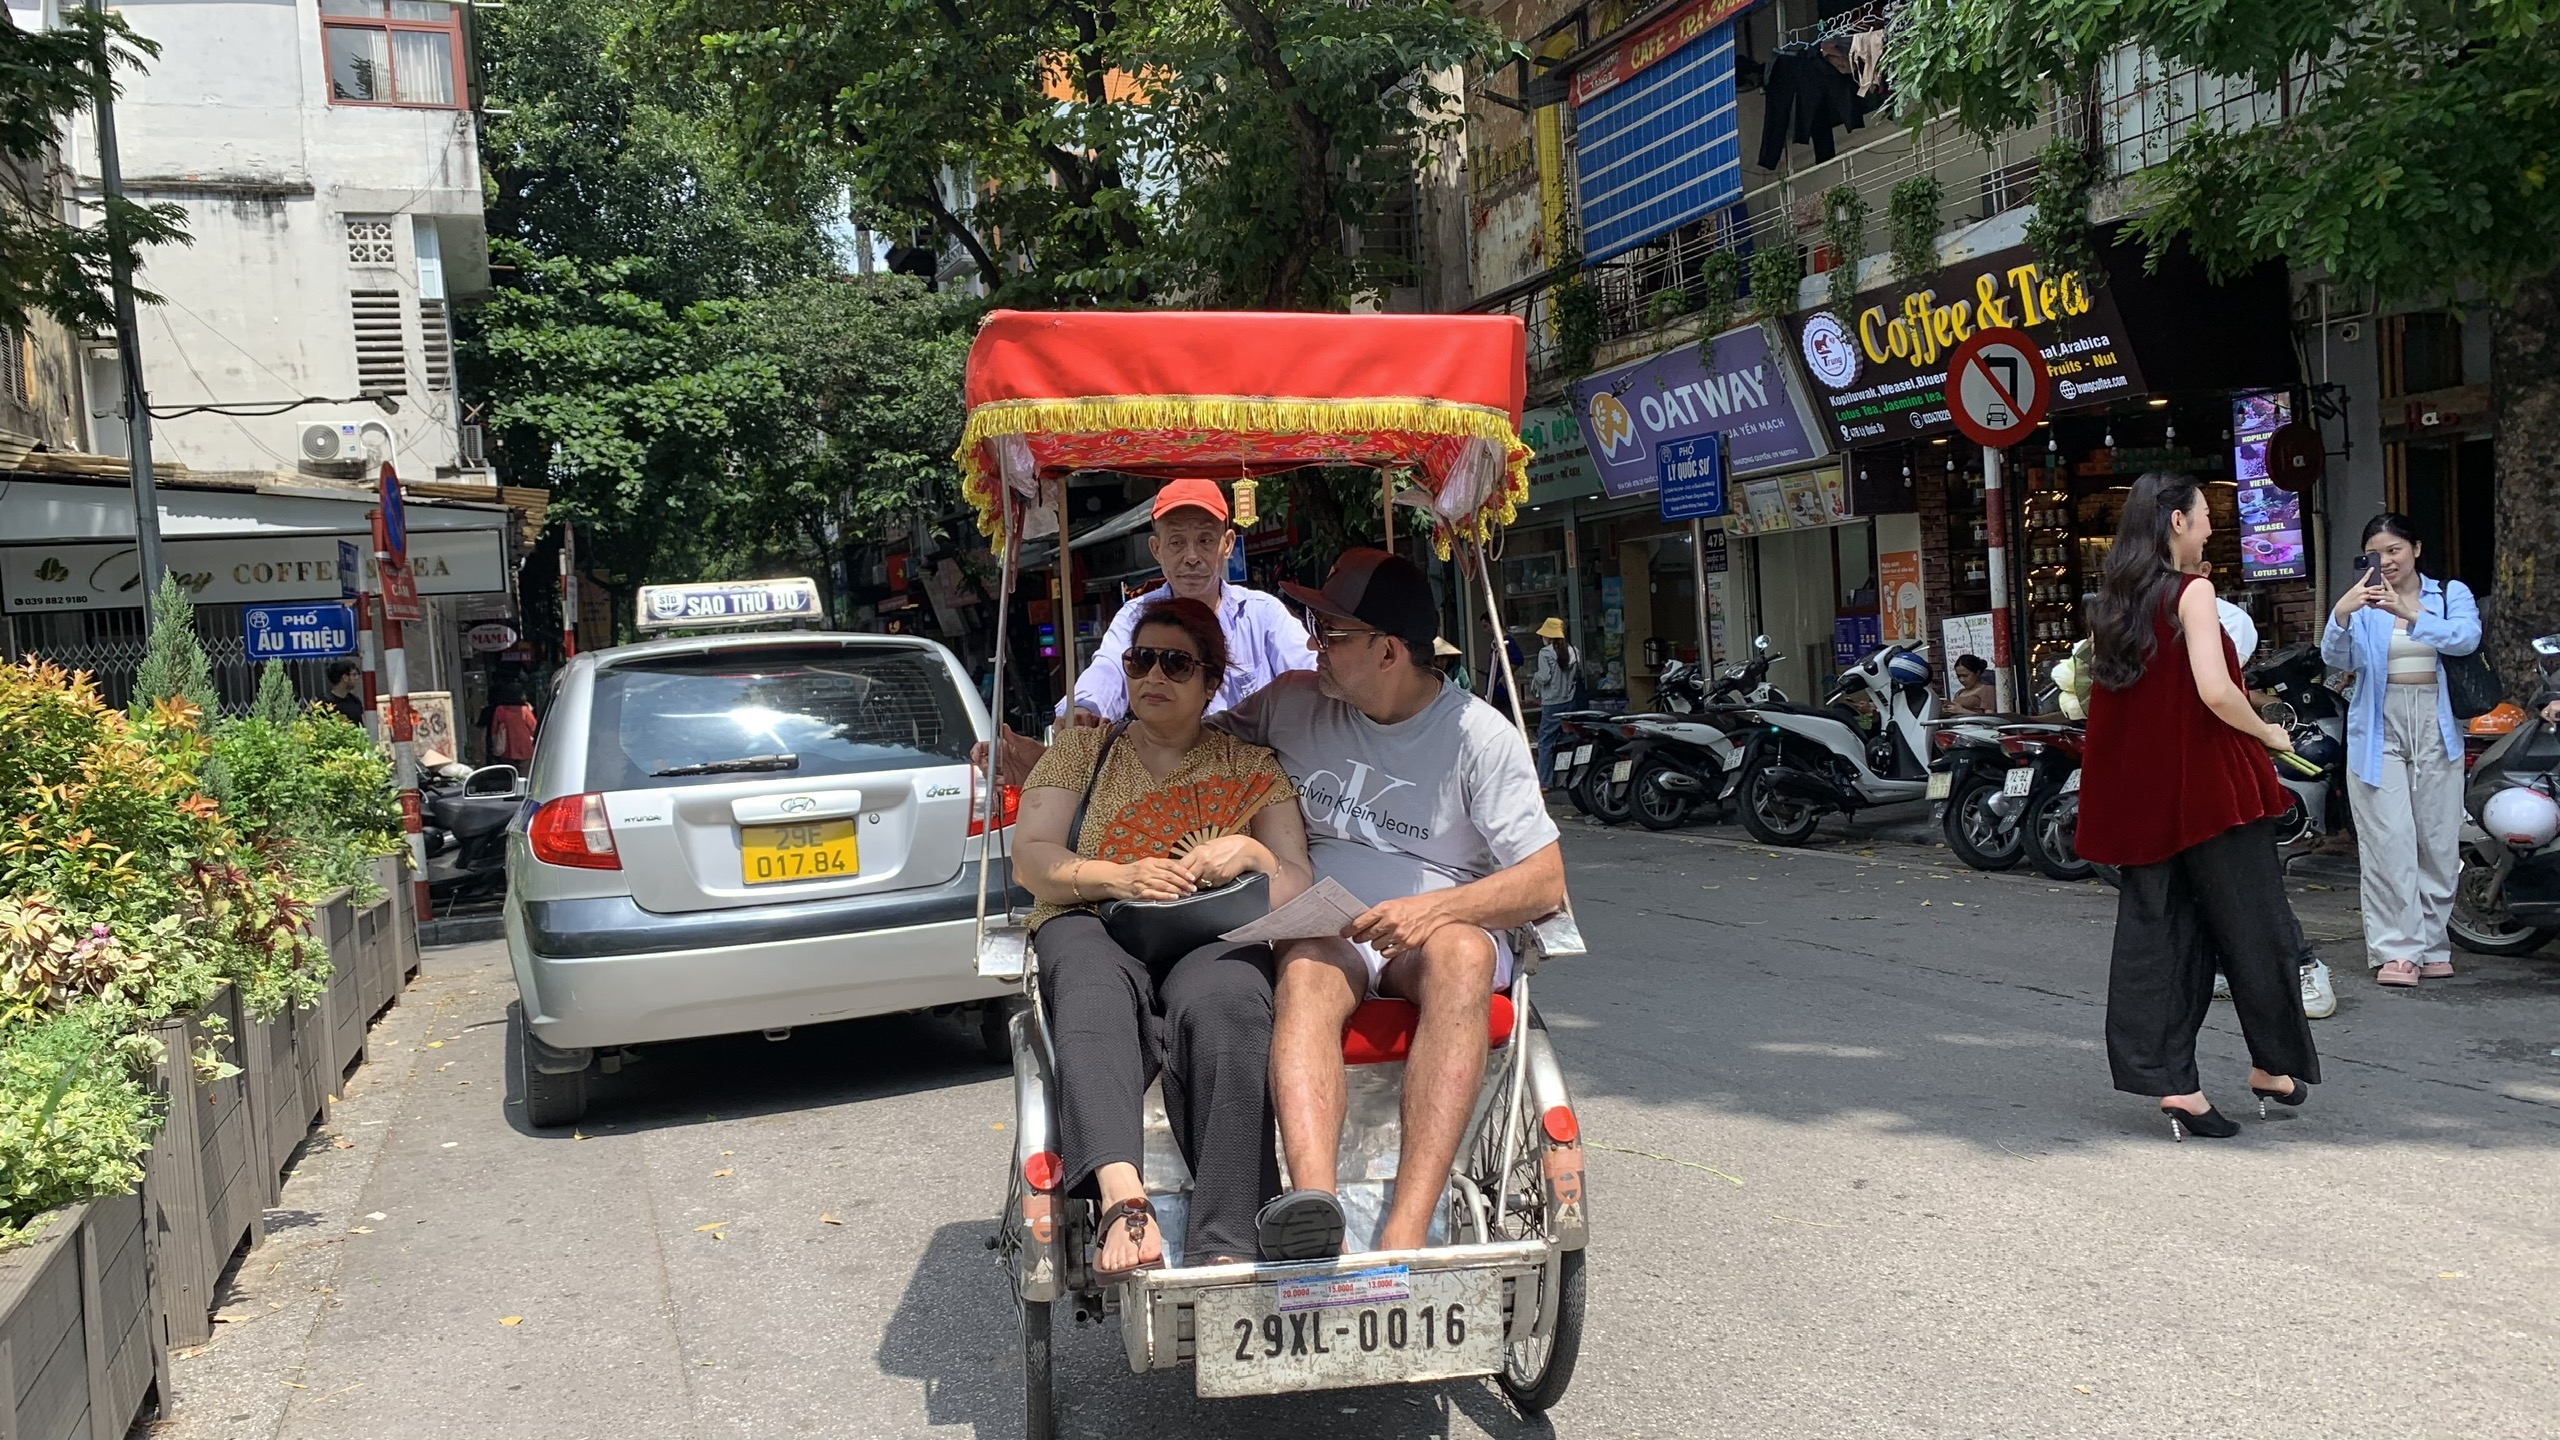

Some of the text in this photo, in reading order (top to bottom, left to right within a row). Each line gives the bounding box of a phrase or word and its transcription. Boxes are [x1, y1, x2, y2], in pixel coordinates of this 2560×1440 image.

[1860, 264, 2090, 367] Coffee & Tea
[1821, 355, 1844, 368] Trung
[1835, 408, 1861, 422] Lotus
[1883, 395, 1924, 413] Jasmine
[2046, 360, 2083, 378] Fruits
[2092, 351, 2118, 368] Nut
[1640, 364, 1771, 433] OATWAY
[1758, 417, 1786, 432] MẠCH
[2242, 431, 2273, 443] KOPILUW
[1679, 440, 1695, 457] PHỐ
[1667, 455, 1711, 482] LÝ QUỐC SƯ
[2249, 478, 2273, 488] VIETN
[2254, 522, 2286, 532] WEASEL
[1706, 533, 1725, 548] 47B
[232, 559, 341, 585] COFFE
[2253, 567, 2294, 577] LOTUS TEA
[25, 595, 88, 605] 039 882 9180
[659, 595, 677, 604] STD
[687, 595, 727, 617] SAO
[282, 610, 318, 626] PHỐ
[257, 626, 346, 652] ẤU TRIỆU
[472, 633, 511, 644] MAMA
[926, 785, 961, 799] Getz
[624, 814, 662, 823] HYUNDAI
[1333, 795, 1377, 824] Klein
[1376, 810, 1430, 840] Jeans
[775, 825, 824, 851] 29E
[756, 850, 846, 878] 017.84
[1233, 1302, 1466, 1361] 29XL-0016
